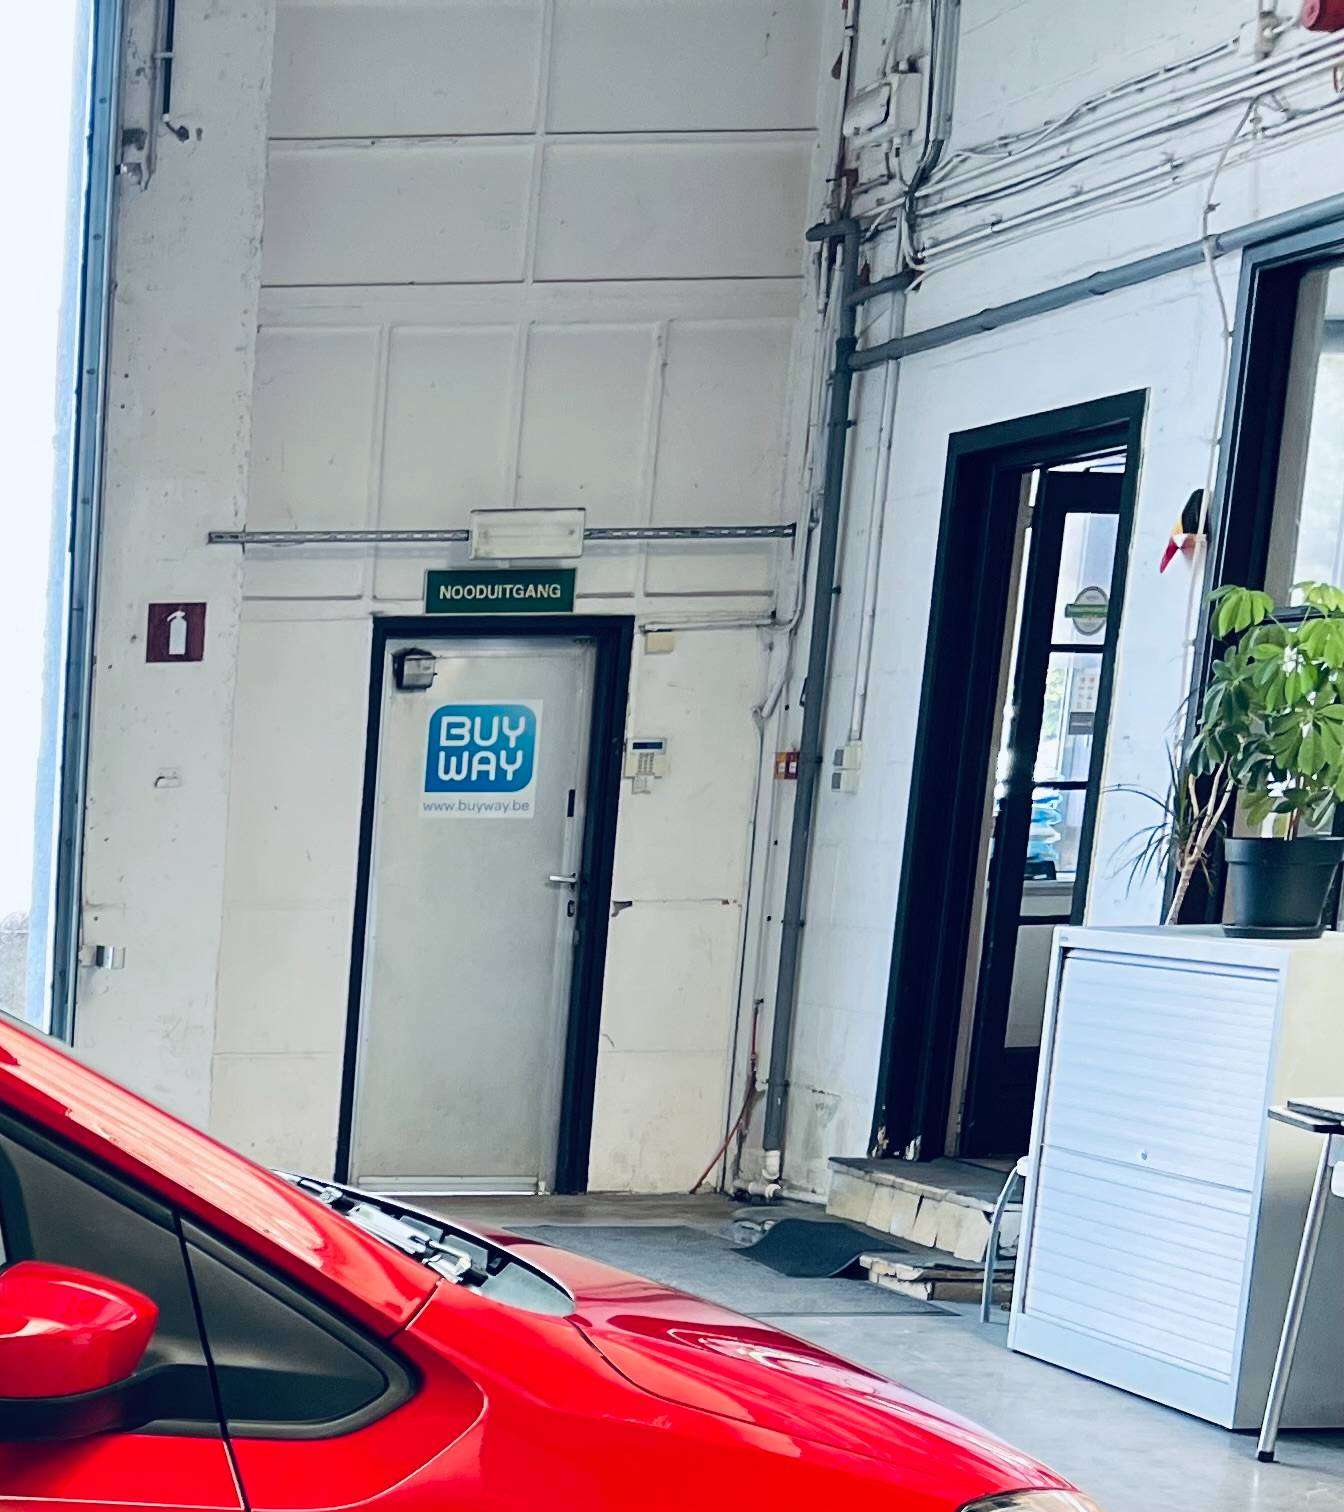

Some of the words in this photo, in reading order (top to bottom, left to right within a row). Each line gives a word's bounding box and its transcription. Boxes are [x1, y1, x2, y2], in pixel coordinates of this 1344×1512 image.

[439, 584, 561, 600] NOODUITGANG
[439, 715, 526, 748] BUY
[437, 749, 524, 781] WAY
[422, 799, 530, 814] www.buyway.be
